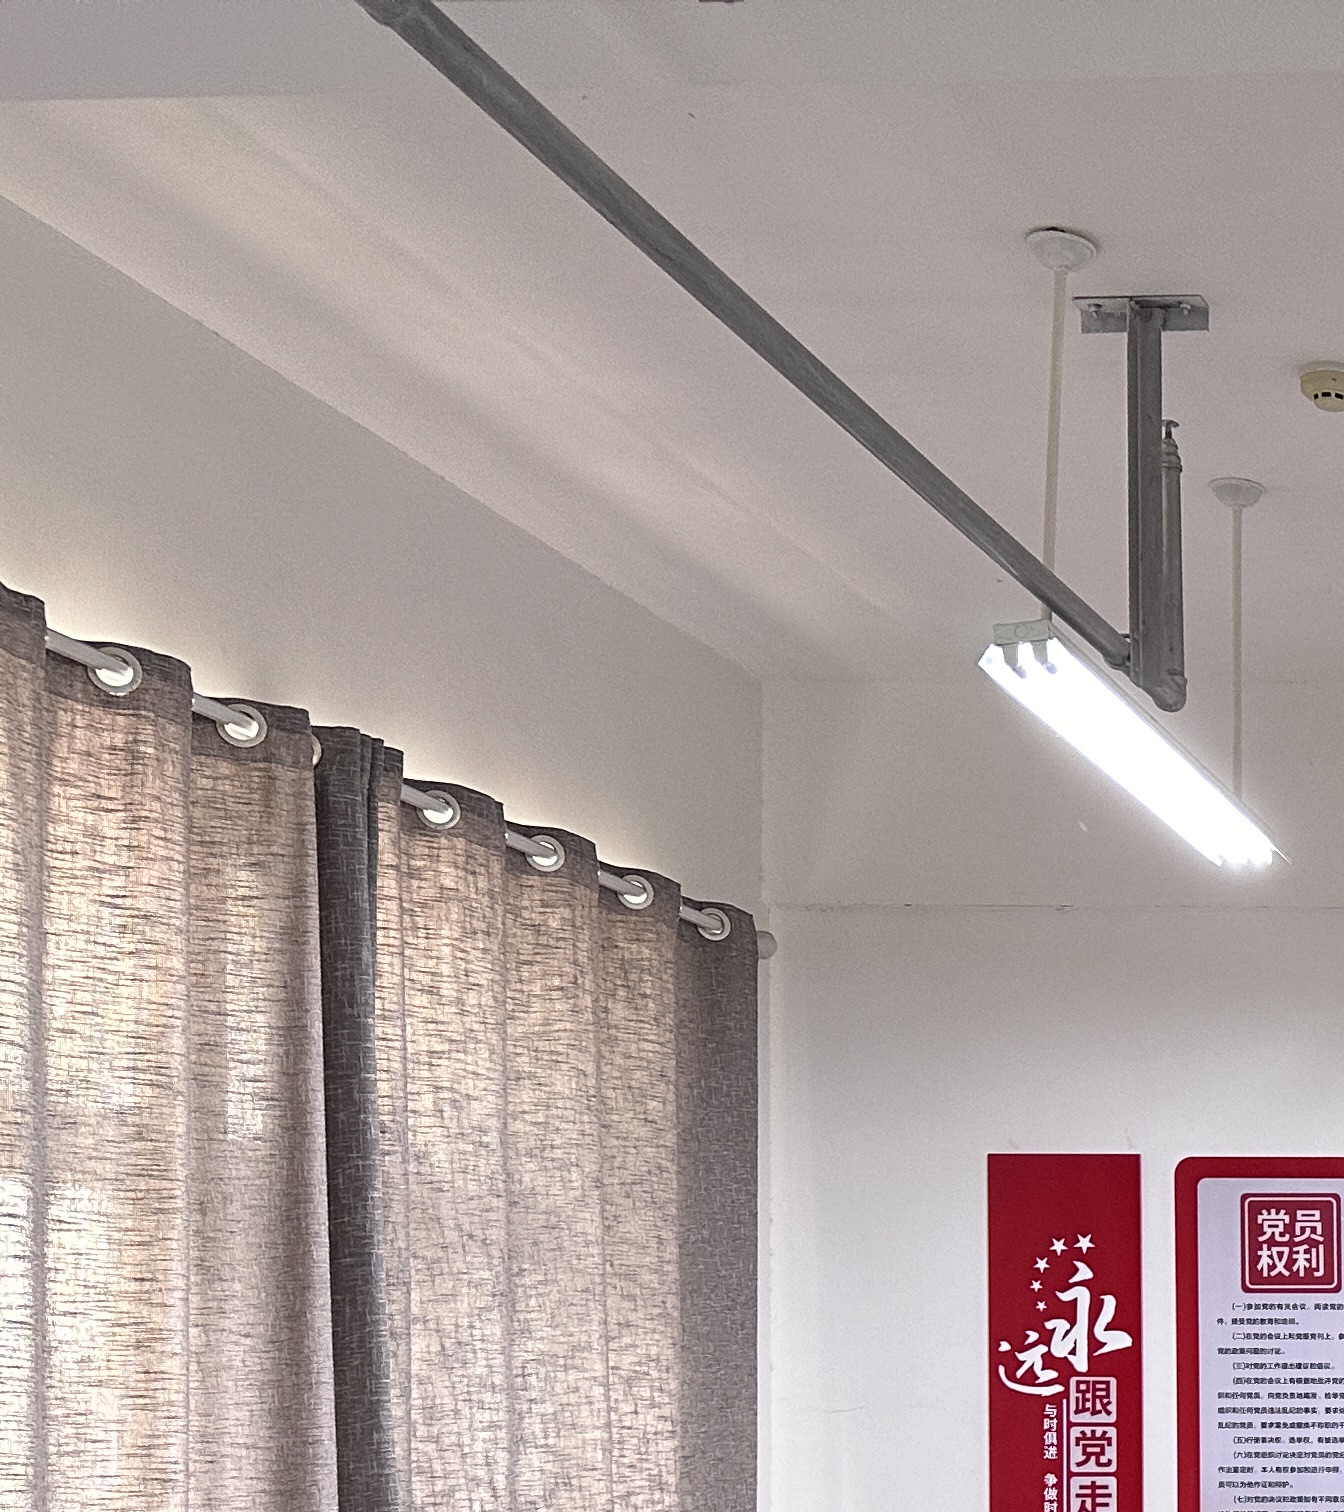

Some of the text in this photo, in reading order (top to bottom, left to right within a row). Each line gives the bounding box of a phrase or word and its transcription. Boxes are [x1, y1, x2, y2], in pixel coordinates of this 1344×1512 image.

[1256, 1208, 1325, 1242] 党员
[1256, 1244, 1325, 1278] 权利
[1043, 1403, 1059, 1460] 与时俱进
